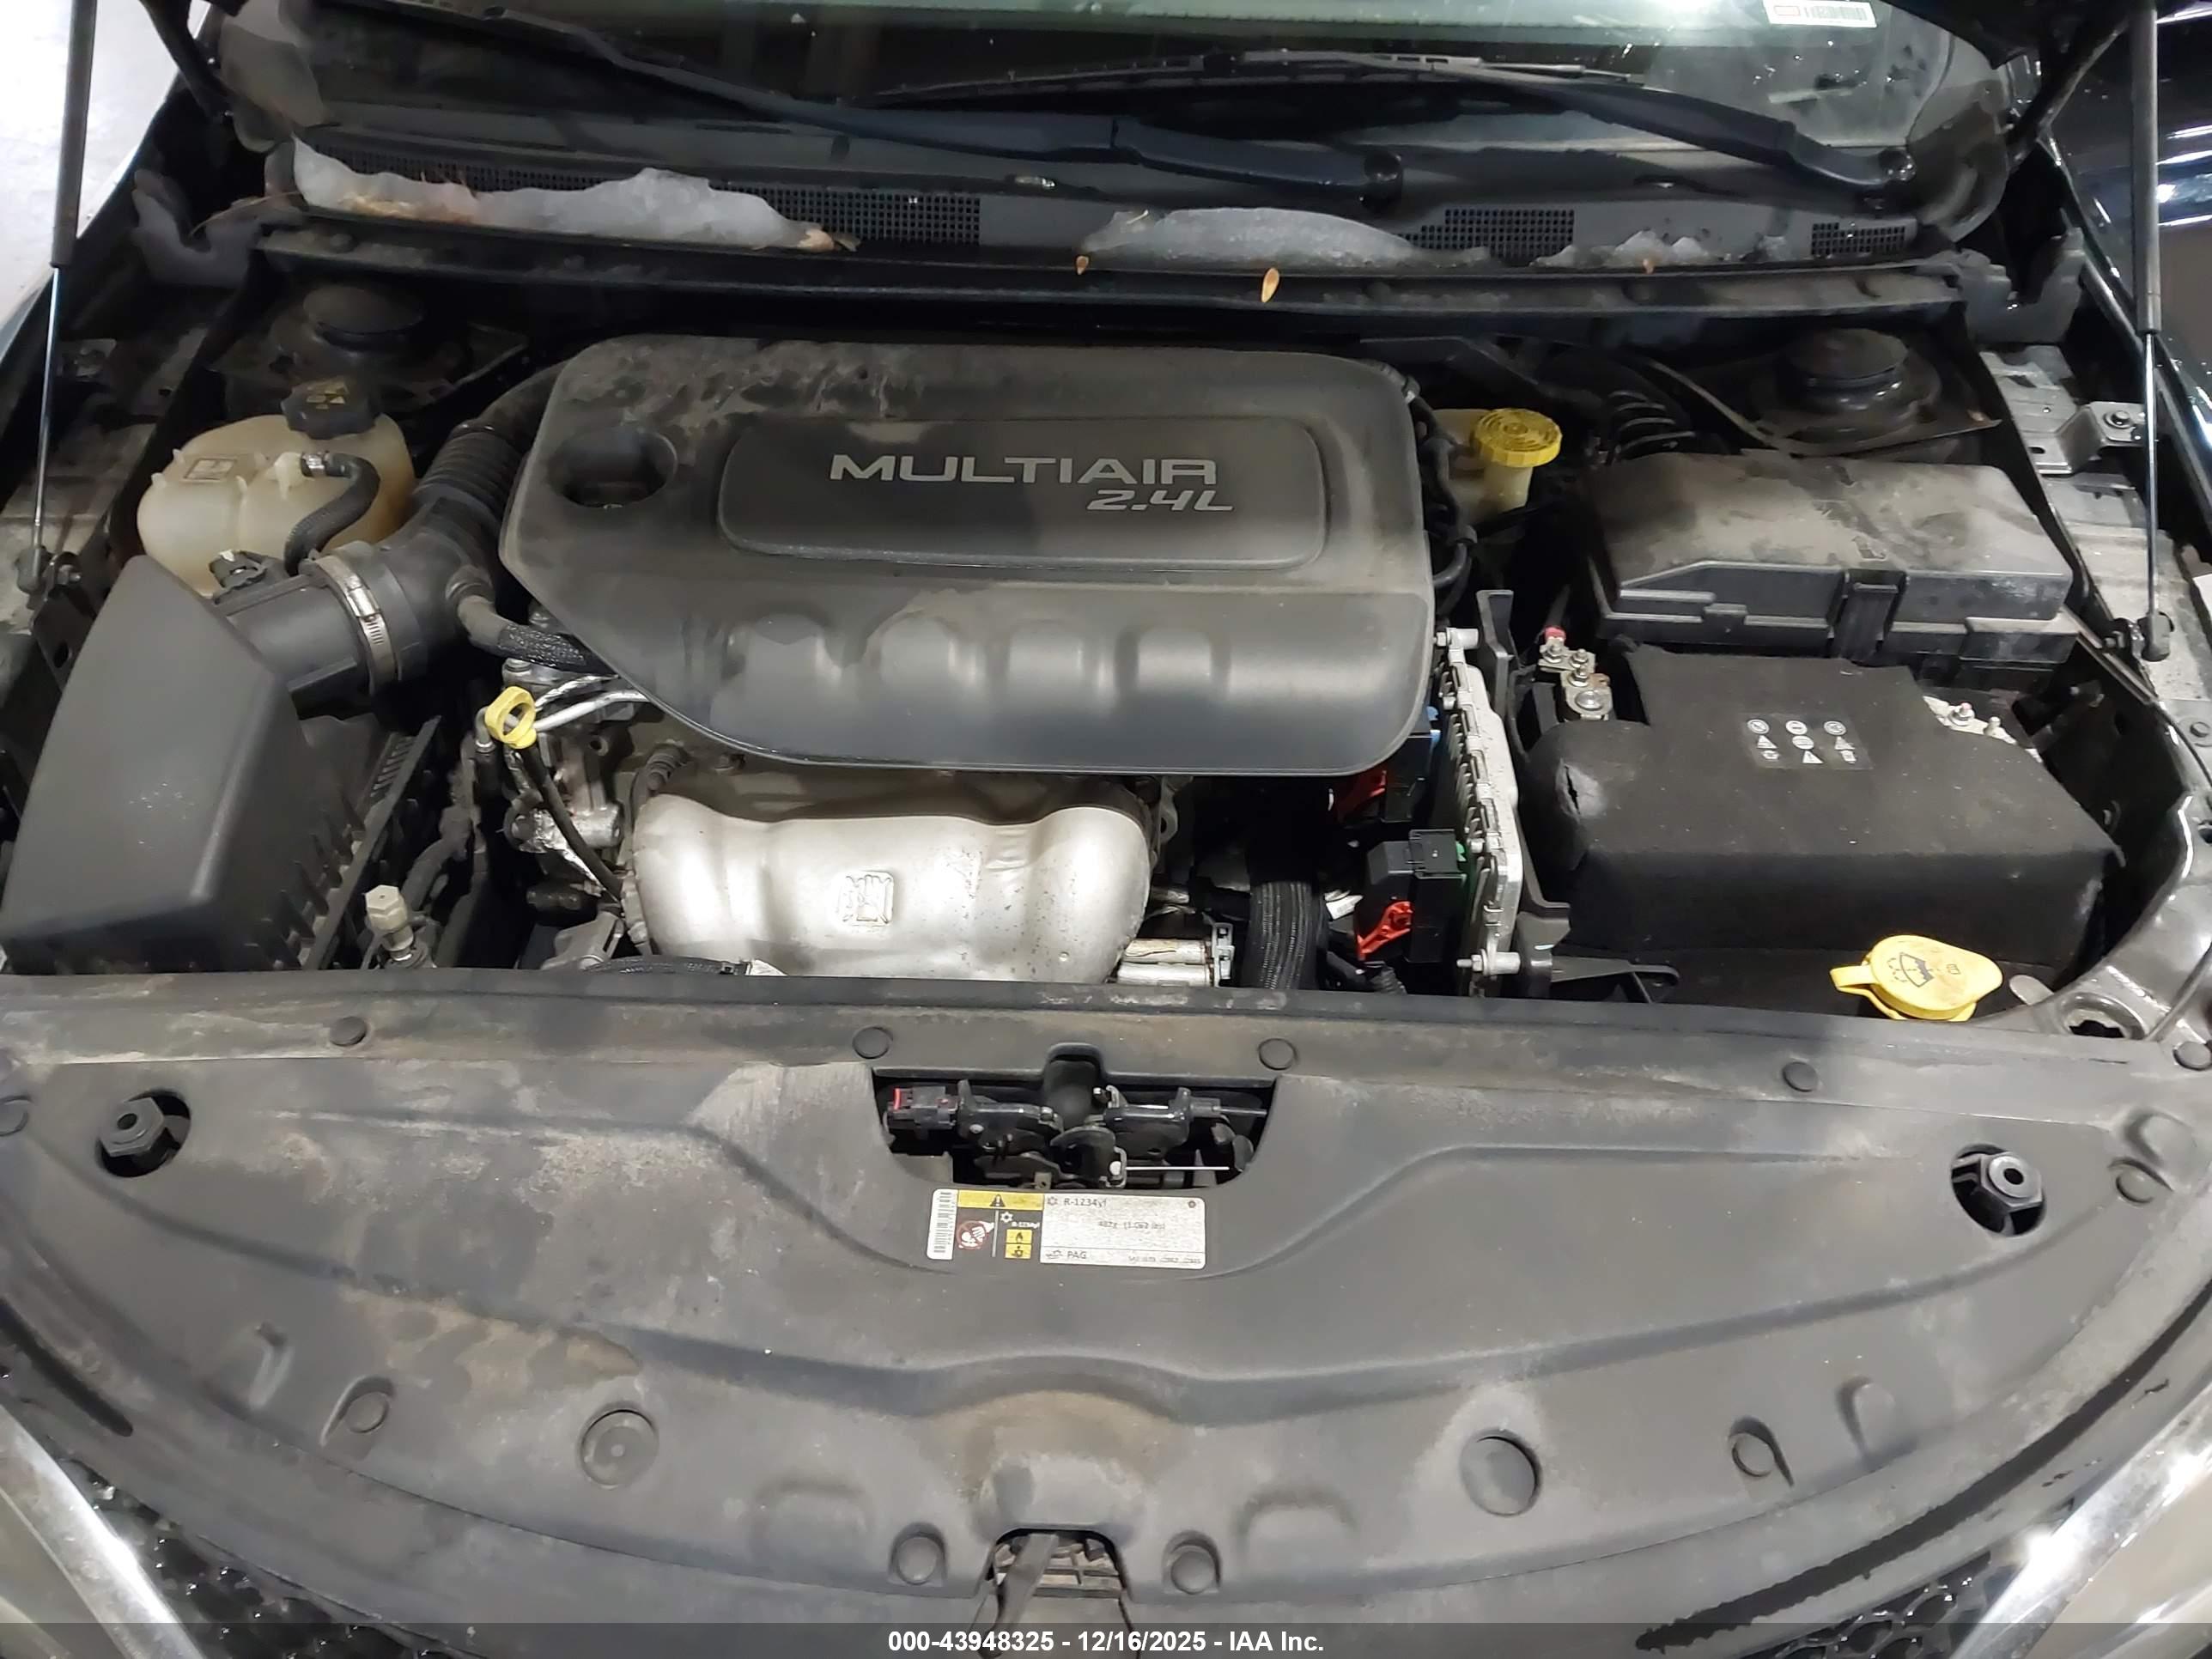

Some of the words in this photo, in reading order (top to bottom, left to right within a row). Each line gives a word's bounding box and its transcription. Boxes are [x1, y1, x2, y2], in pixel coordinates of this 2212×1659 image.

[830, 454, 1217, 484] MULTIAIR
[1086, 489, 1234, 511] 2.4L
[1064, 1197, 1107, 1208] R-1234yf
[1066, 1250, 1087, 1260] PAG
